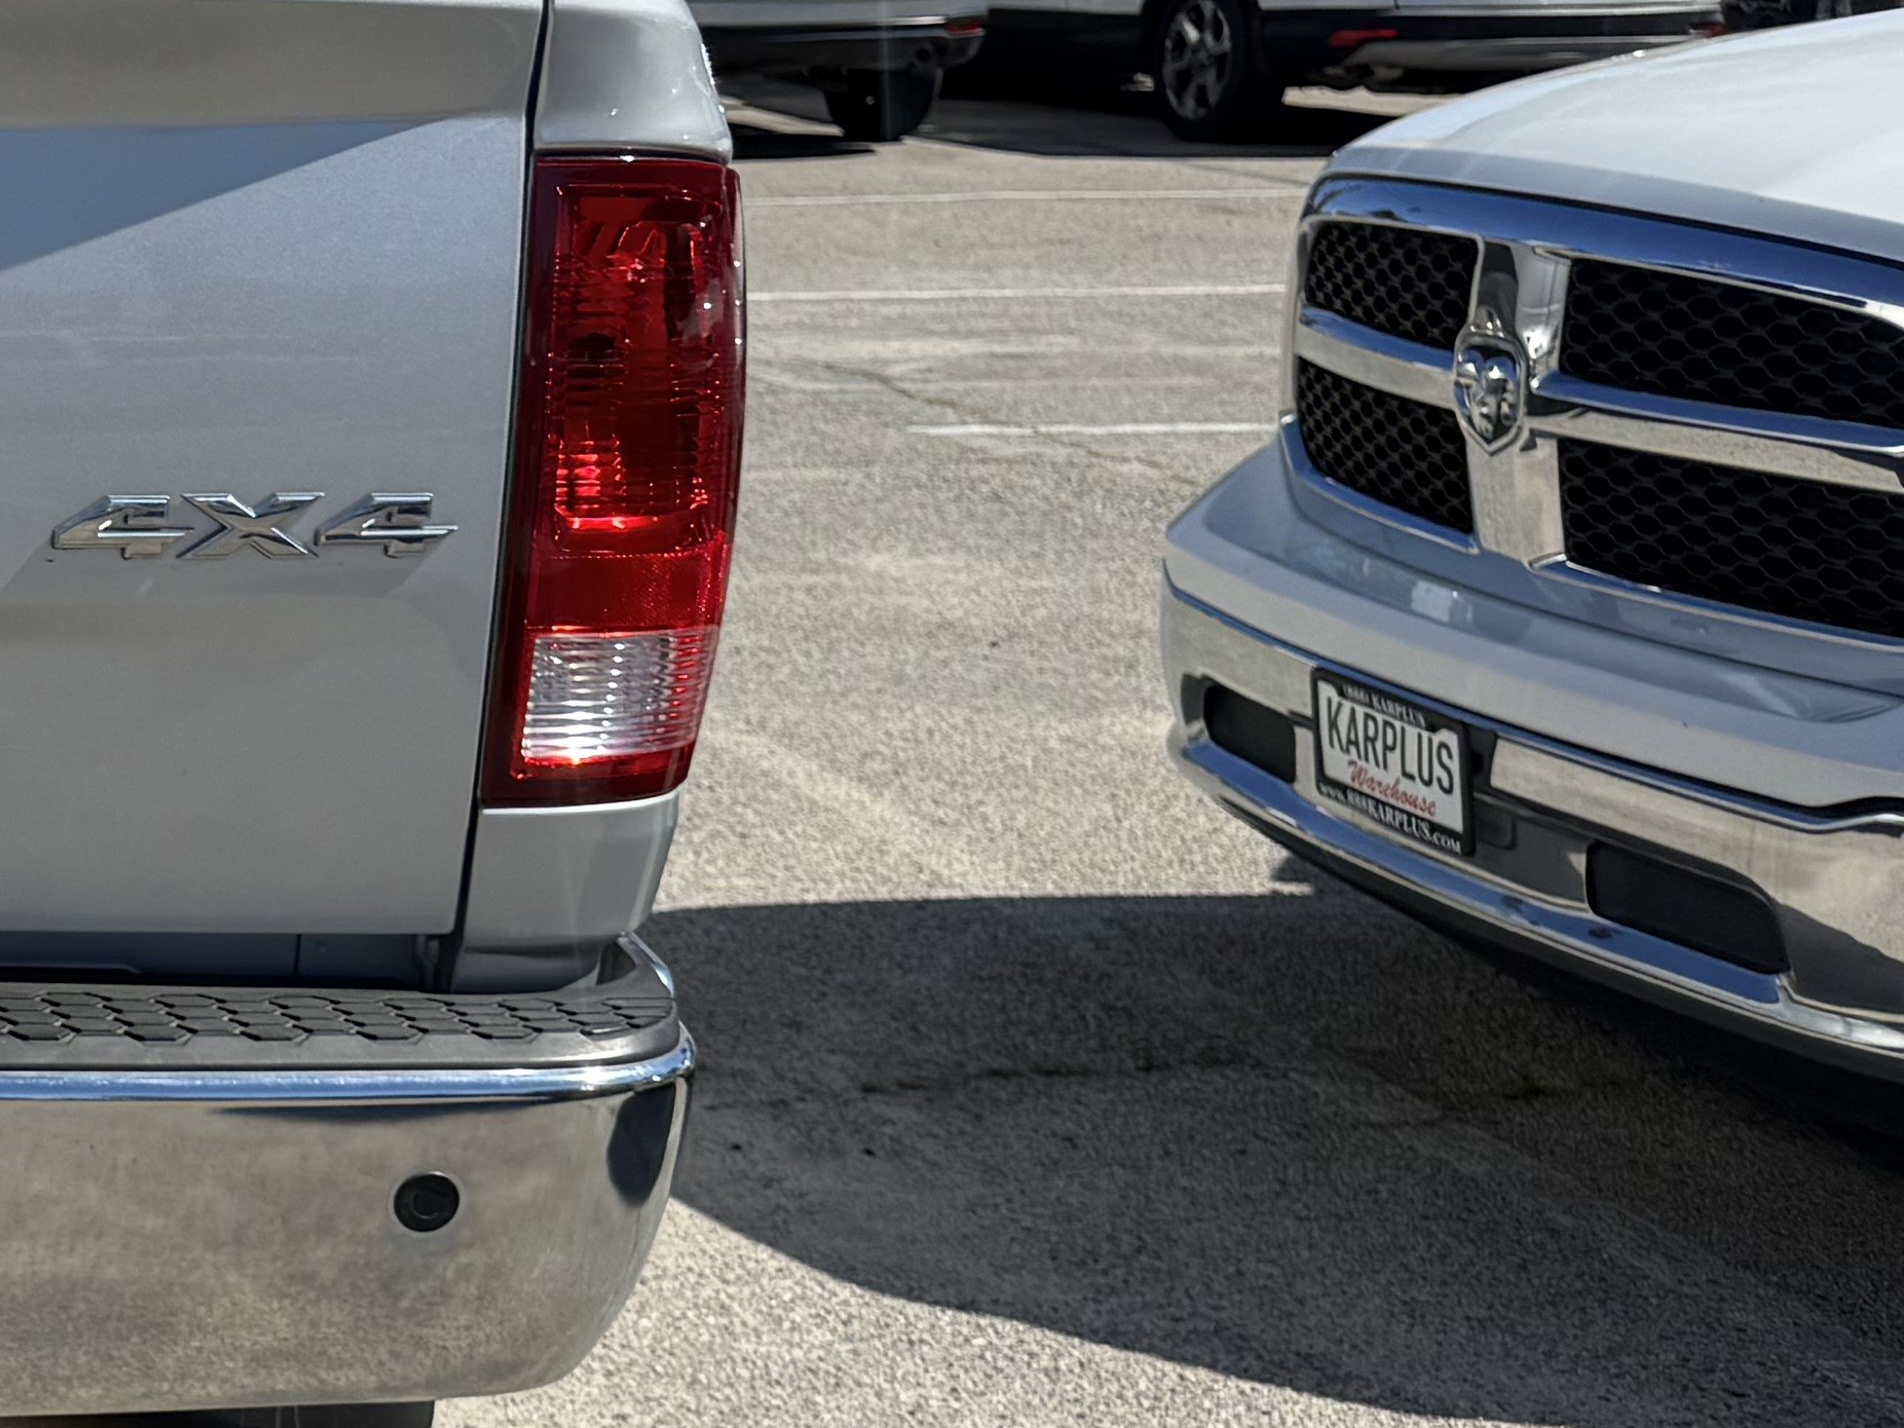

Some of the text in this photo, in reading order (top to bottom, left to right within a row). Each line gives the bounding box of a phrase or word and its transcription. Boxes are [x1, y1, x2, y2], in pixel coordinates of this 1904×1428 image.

[51, 491, 458, 560] 4X4
[1371, 695, 1426, 728] KARPLUS
[1326, 695, 1454, 795] KARPLUS
[1347, 759, 1437, 817] Warehouse
